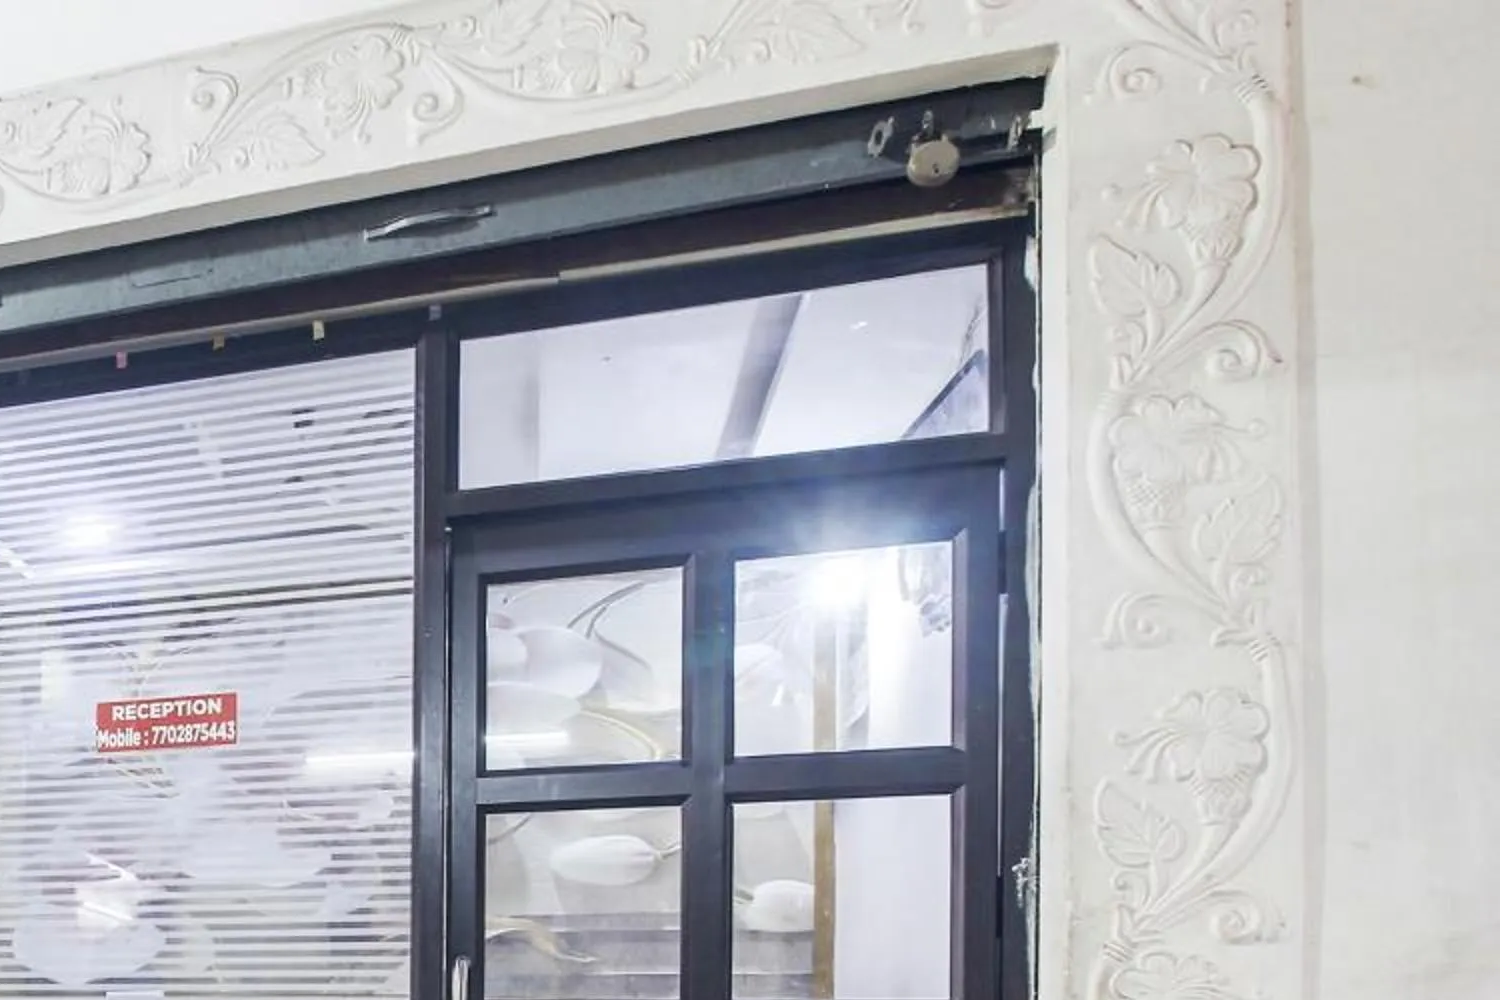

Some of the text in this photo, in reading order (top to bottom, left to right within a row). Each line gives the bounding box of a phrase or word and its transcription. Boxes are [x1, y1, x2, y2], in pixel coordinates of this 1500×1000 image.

[111, 698, 222, 721] RECEPTION
[98, 728, 141, 748] Mobile
[151, 721, 235, 745] 7702875443
